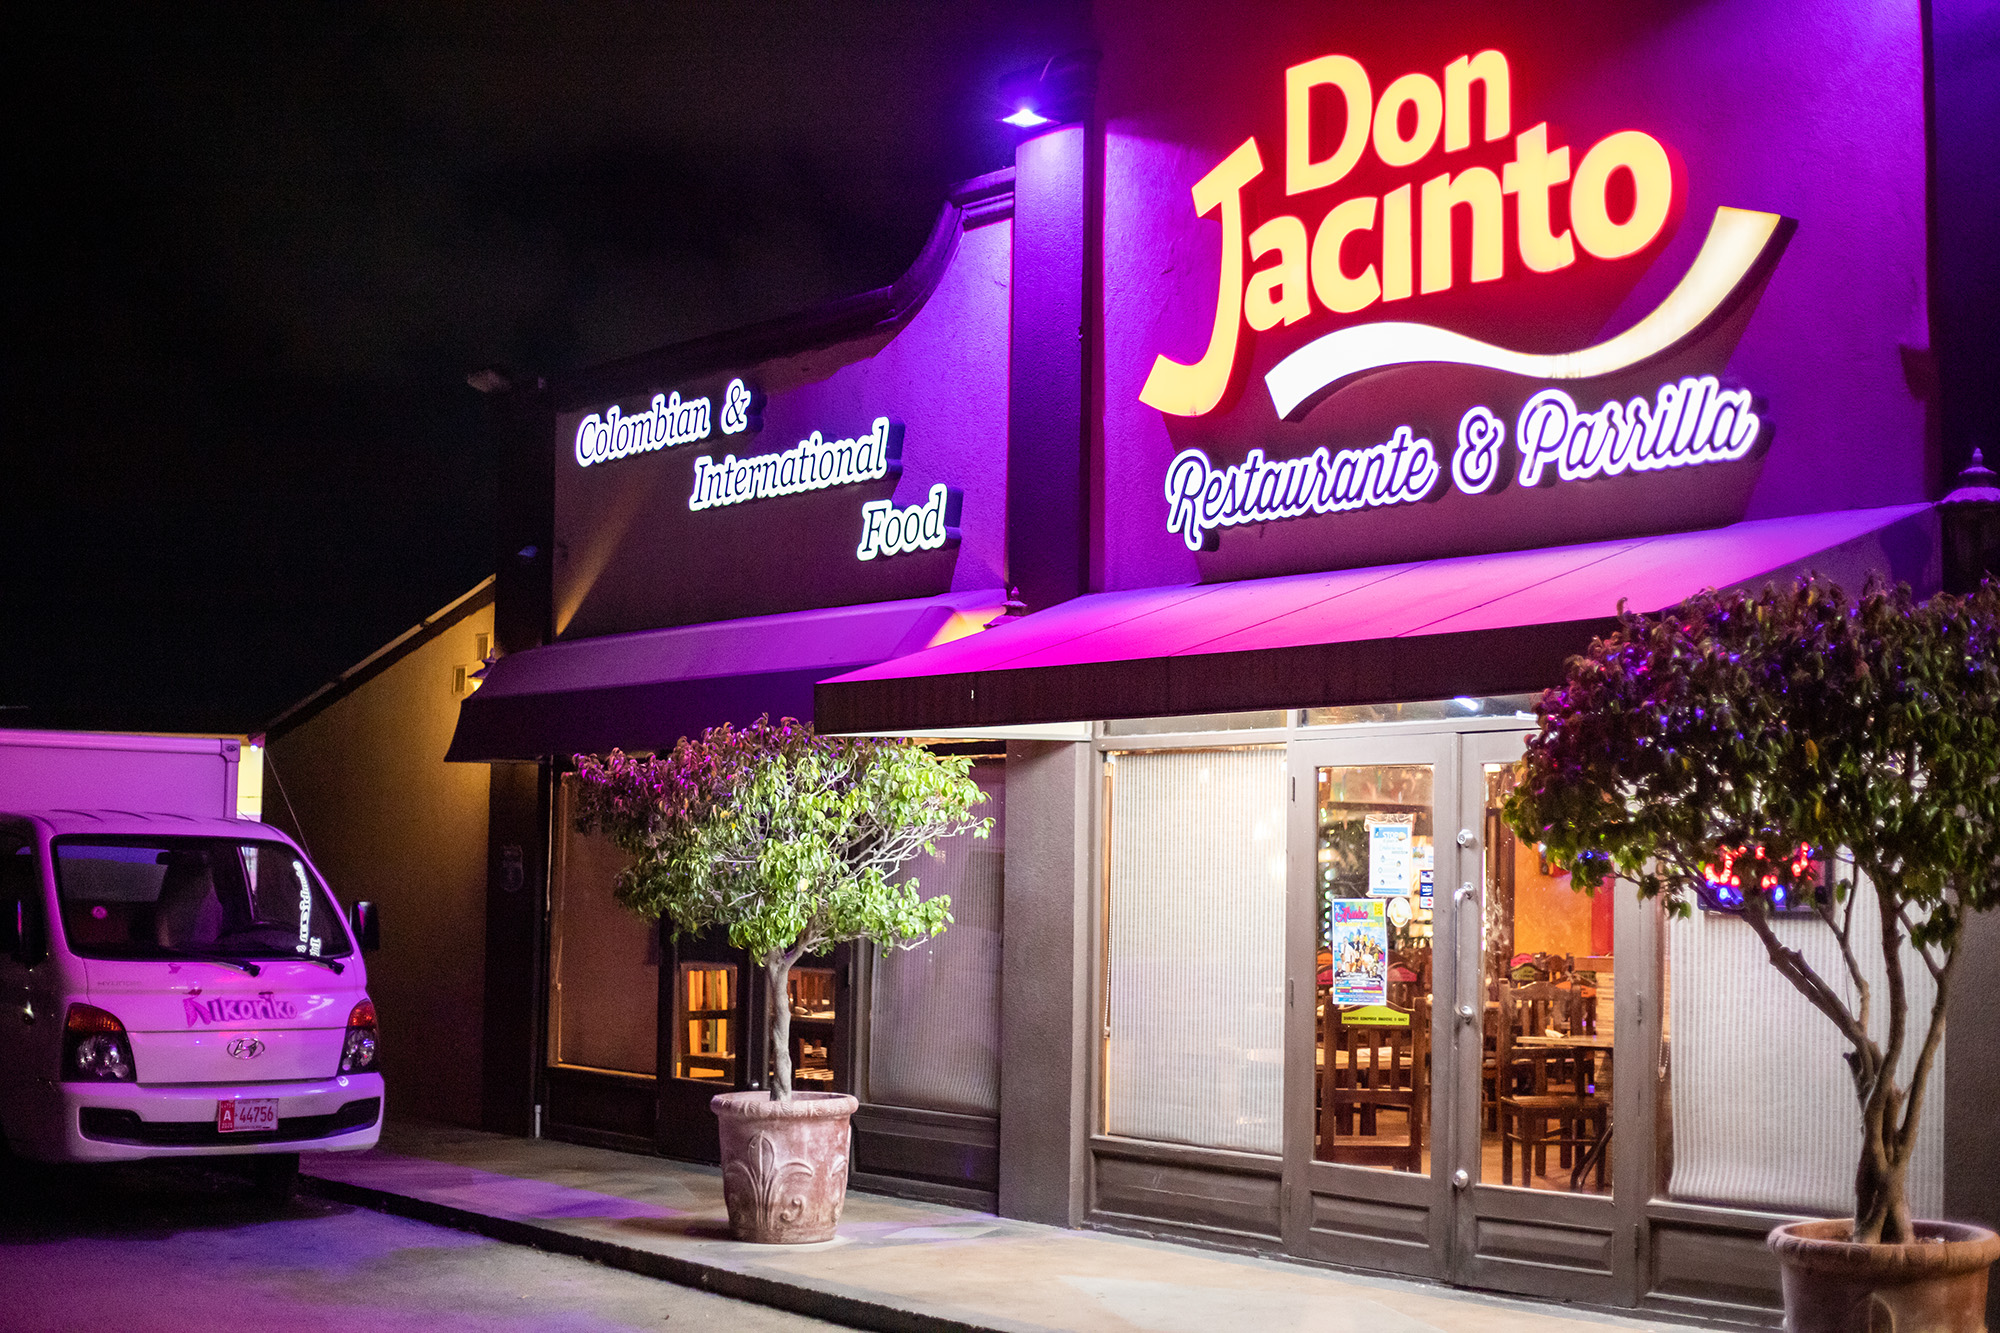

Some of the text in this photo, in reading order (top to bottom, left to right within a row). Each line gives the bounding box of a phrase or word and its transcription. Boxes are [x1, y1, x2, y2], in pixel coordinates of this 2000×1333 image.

[1286, 49, 1511, 196] Don
[1138, 122, 1673, 417] Jacinto
[575, 378, 751, 467] Colombian &
[689, 416, 890, 511] International
[1164, 375, 1759, 551] Restaurante & Parrilla
[857, 483, 947, 561] Food
[223, 1106, 274, 1122] A 44756
